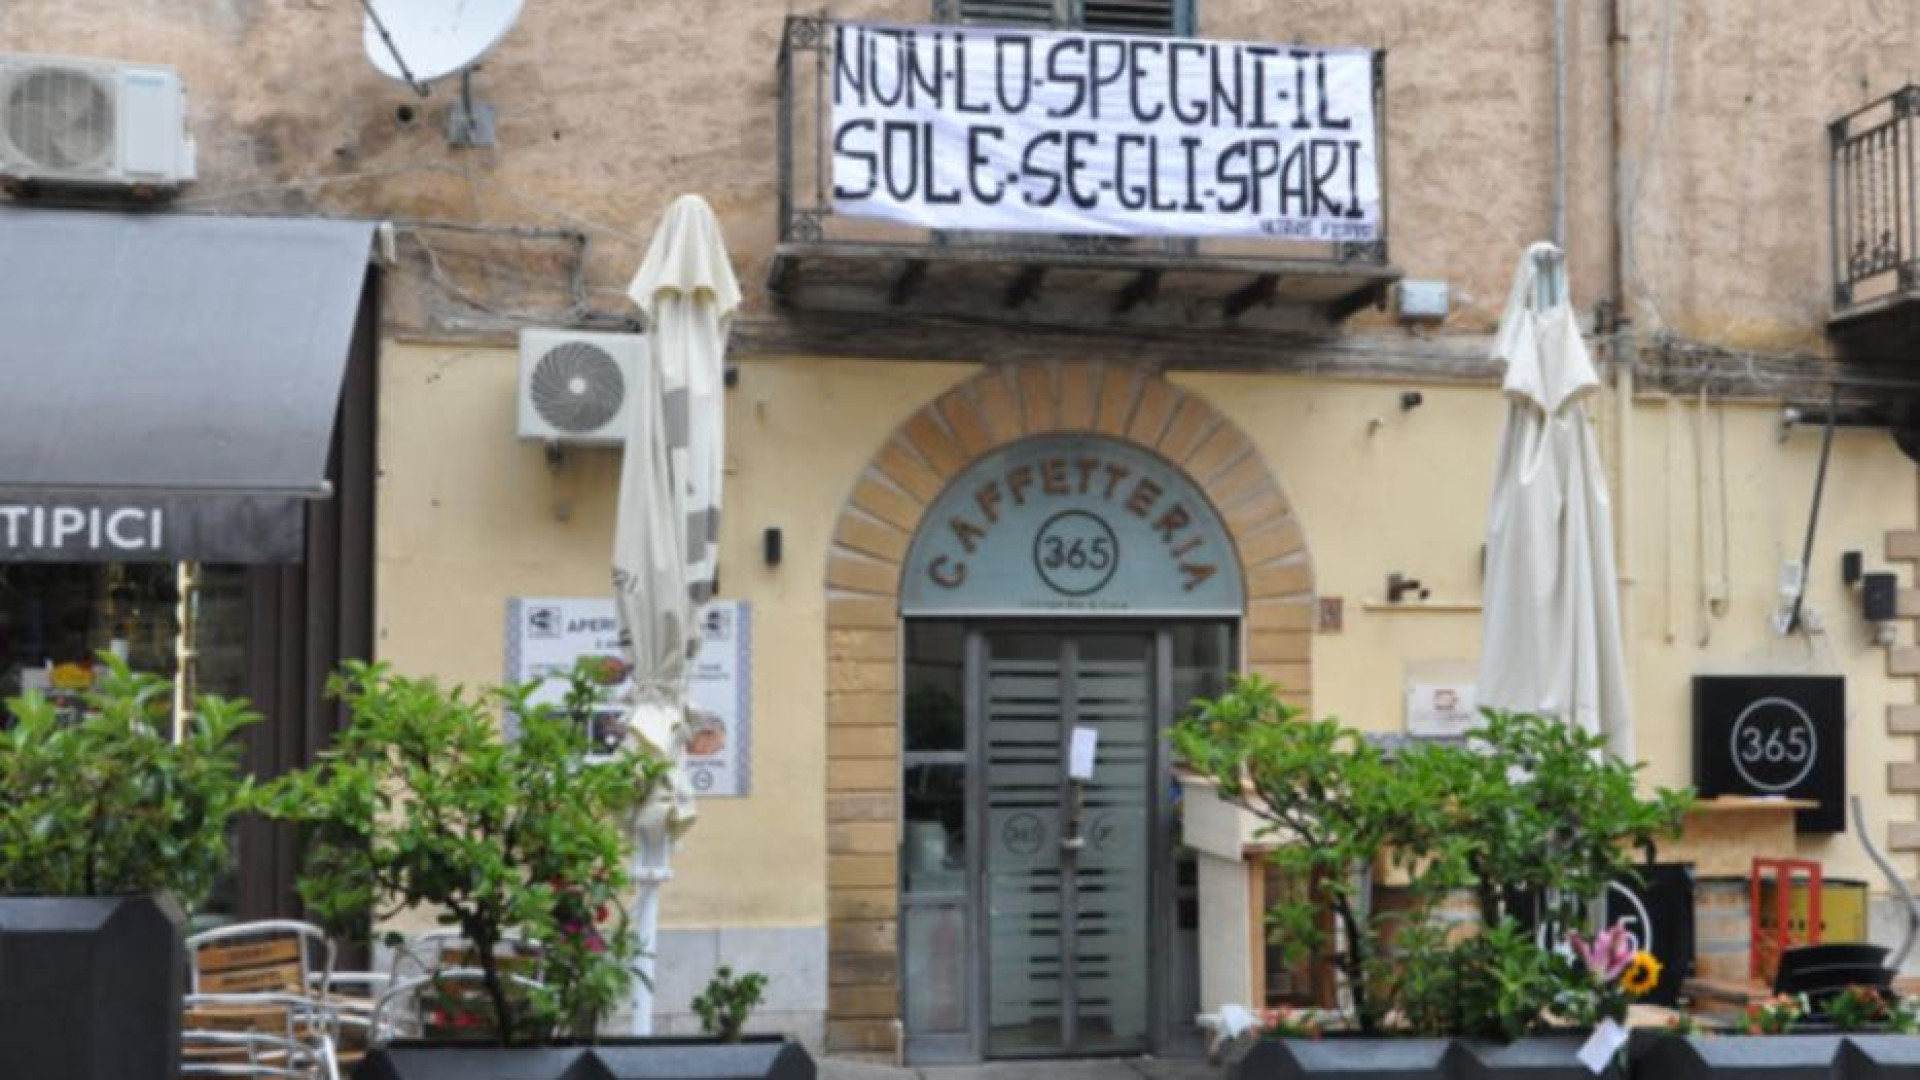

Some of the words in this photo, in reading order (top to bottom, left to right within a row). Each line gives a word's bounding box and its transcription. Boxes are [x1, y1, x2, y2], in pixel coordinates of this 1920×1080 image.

[0, 505, 163, 549] TIPICI
[926, 458, 1218, 592] CAFFETTERIA
[1044, 536, 1110, 571] 365
[1742, 726, 1808, 762] 365
